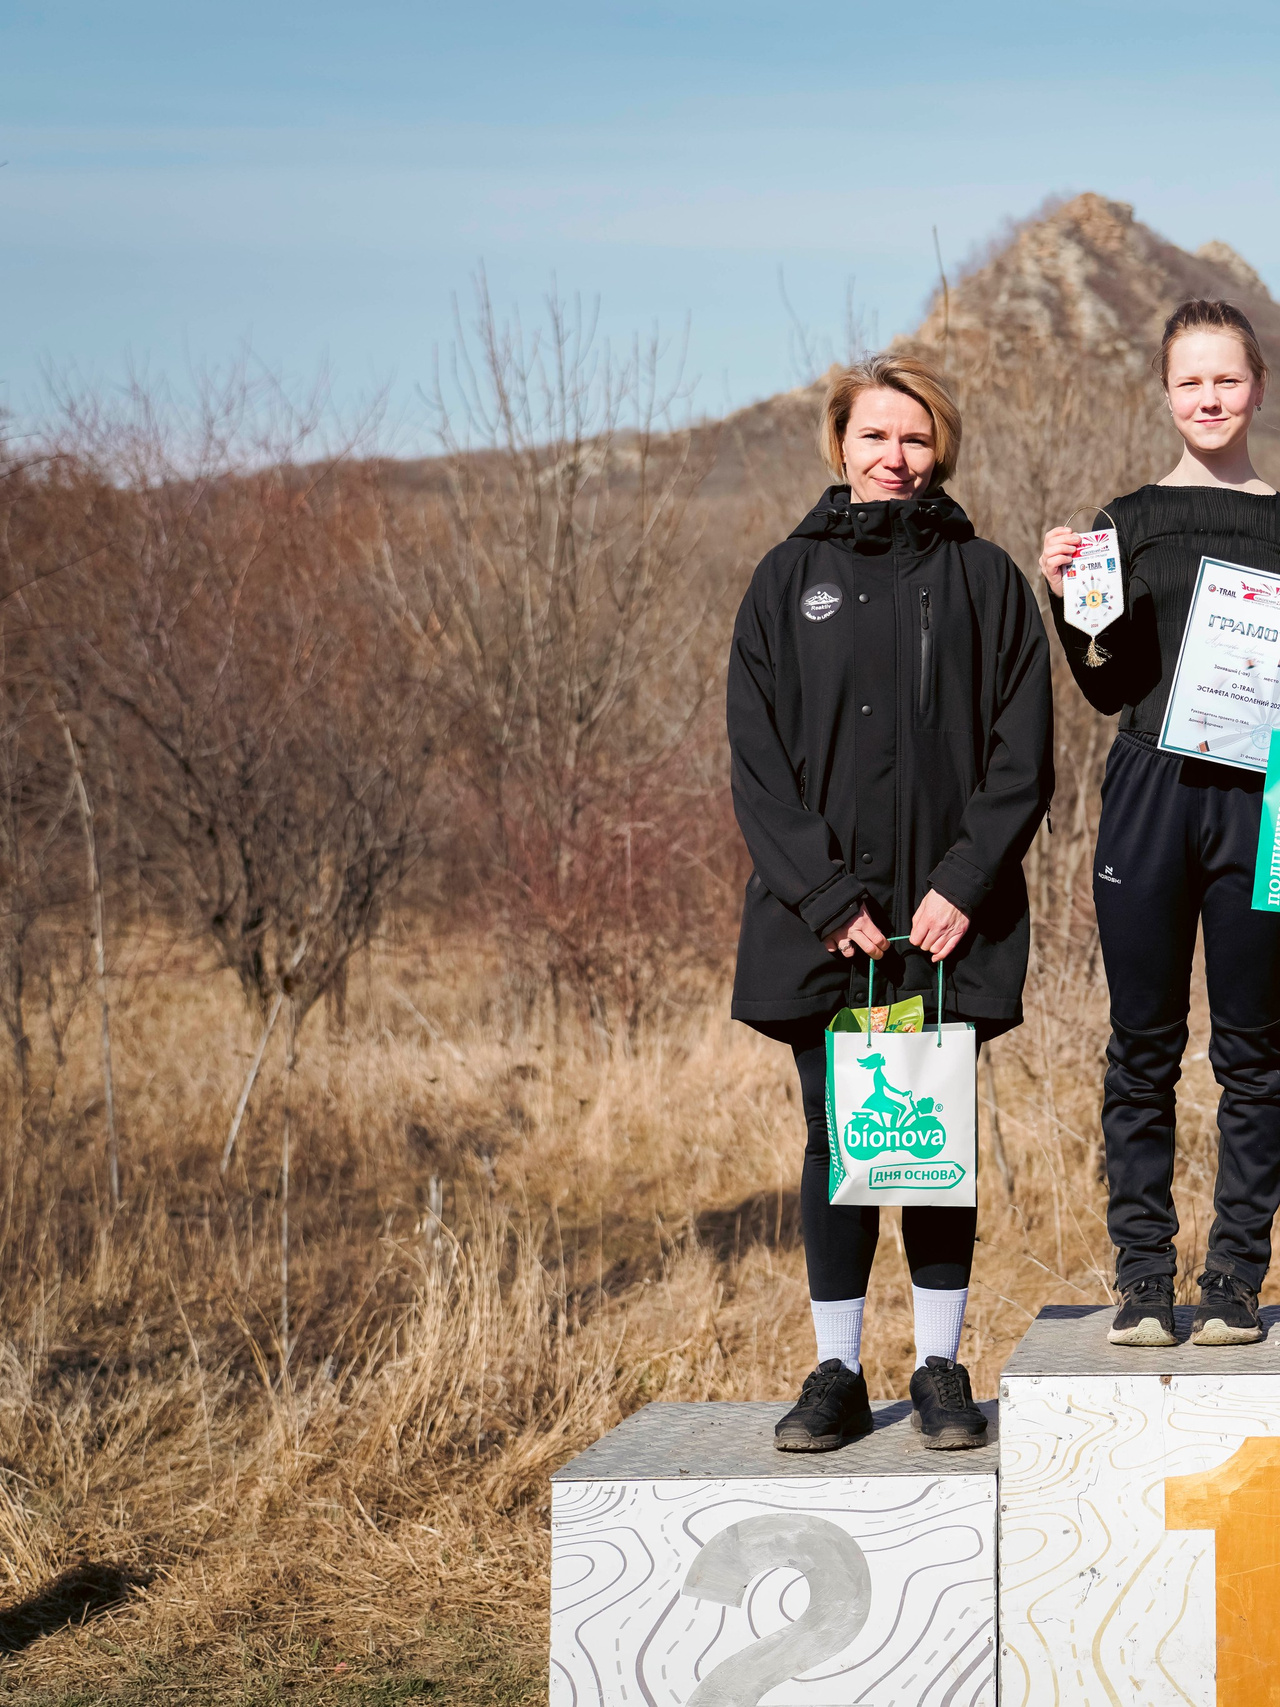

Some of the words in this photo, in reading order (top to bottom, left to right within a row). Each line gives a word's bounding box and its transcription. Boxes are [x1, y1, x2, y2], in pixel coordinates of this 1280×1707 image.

[1196, 685, 1229, 698] ЭСТАФЕТА
[1230, 692, 1270, 707] ПОКОЛЕНИЙ
[848, 1122, 945, 1148] bionova
[874, 1171, 900, 1183] ДНЯ
[904, 1169, 957, 1181] ОСНОВА
[682, 1514, 871, 1707] 2
